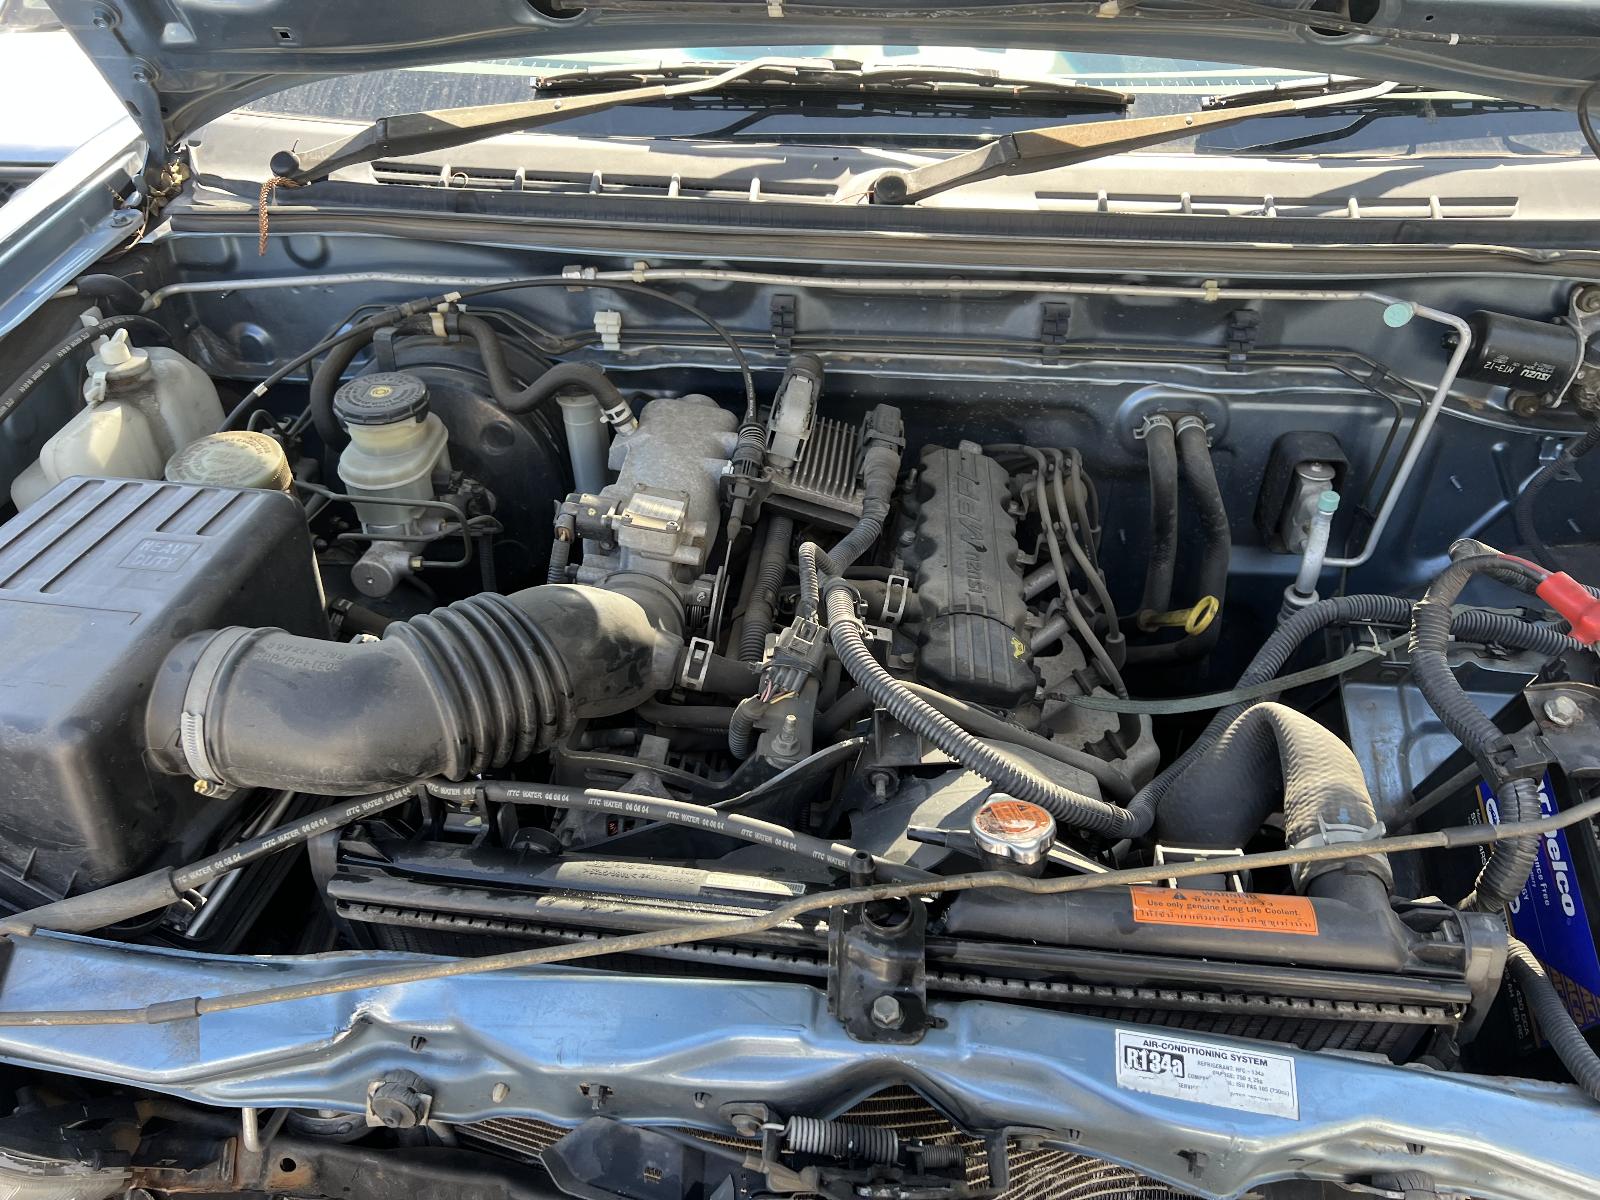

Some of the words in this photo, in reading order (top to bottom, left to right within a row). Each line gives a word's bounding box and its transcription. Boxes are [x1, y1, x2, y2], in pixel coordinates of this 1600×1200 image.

[1520, 369, 1552, 382] ISUZU
[139, 540, 200, 555] HEAVY
[130, 553, 179, 569] DUTY
[440, 786, 460, 796] WATER
[522, 790, 542, 799] WATER
[362, 797, 384, 810] WATER
[603, 799, 623, 810] WATER
[681, 813, 701, 825] WATER
[277, 828, 301, 842] WATER
[754, 832, 773, 845] WATER
[826, 855, 846, 867] WATER
[188, 866, 213, 879] WATER
[1539, 882, 1550, 906] Free
[1222, 904, 1244, 913] Long
[1143, 1039, 1228, 1060] AIR-CONDITIONING
[1230, 1054, 1268, 1067] SYSTEM
[1126, 1046, 1184, 1078] R134a
